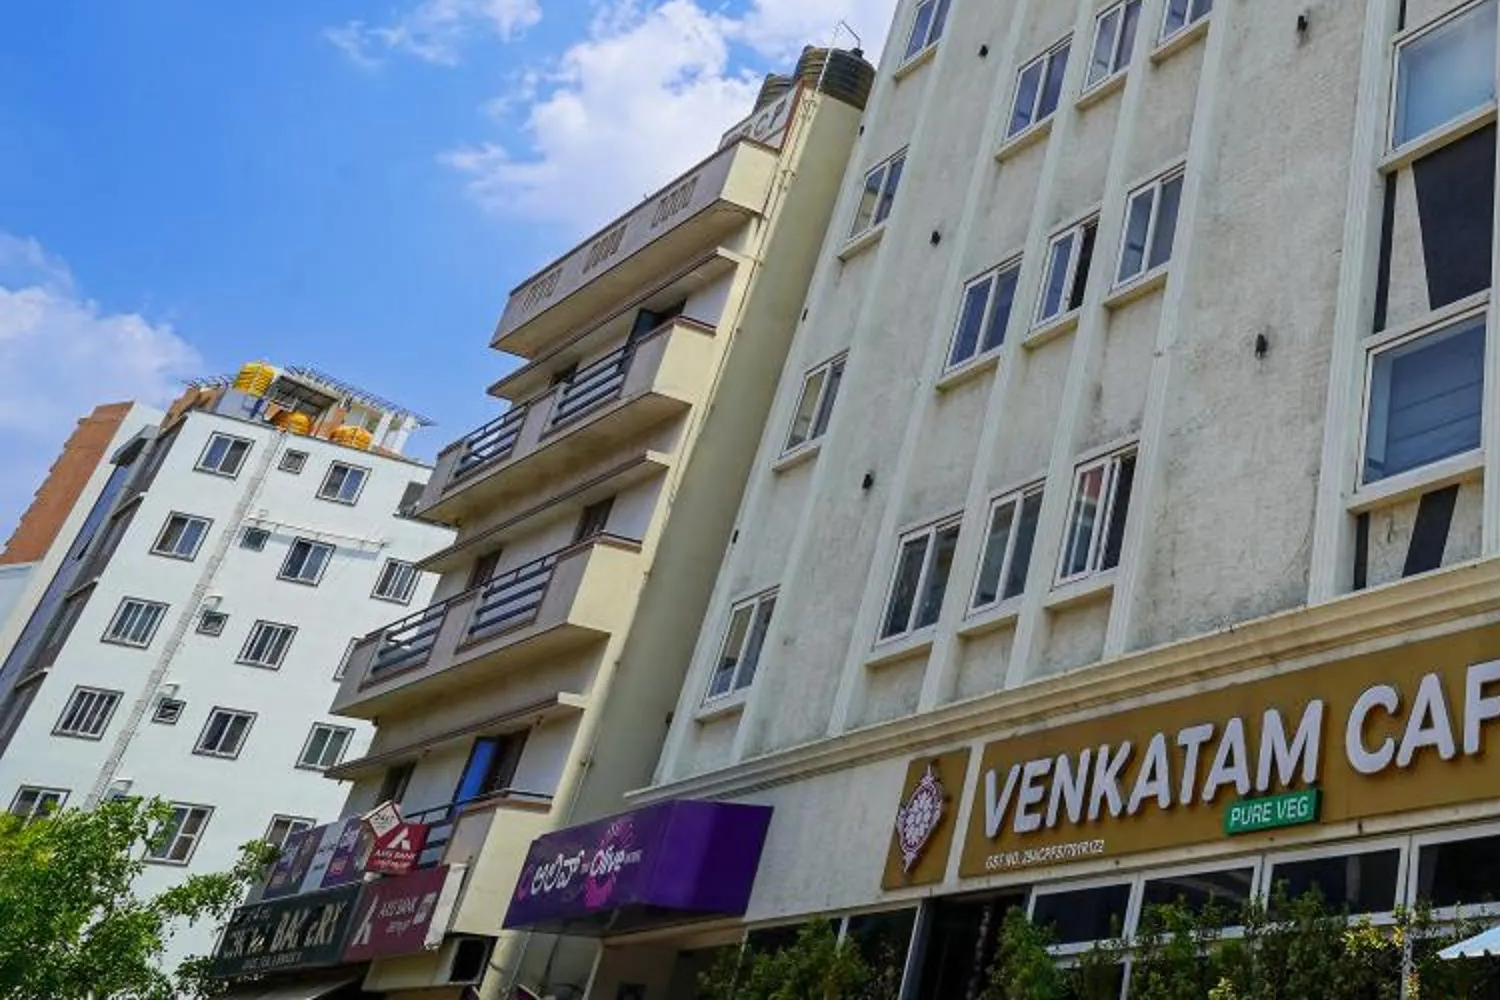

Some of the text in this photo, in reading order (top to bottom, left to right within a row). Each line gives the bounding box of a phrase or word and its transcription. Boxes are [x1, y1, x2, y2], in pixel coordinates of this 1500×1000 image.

[984, 699, 1325, 840] VENKATAM
[1229, 796, 1310, 827] PURE VEG
